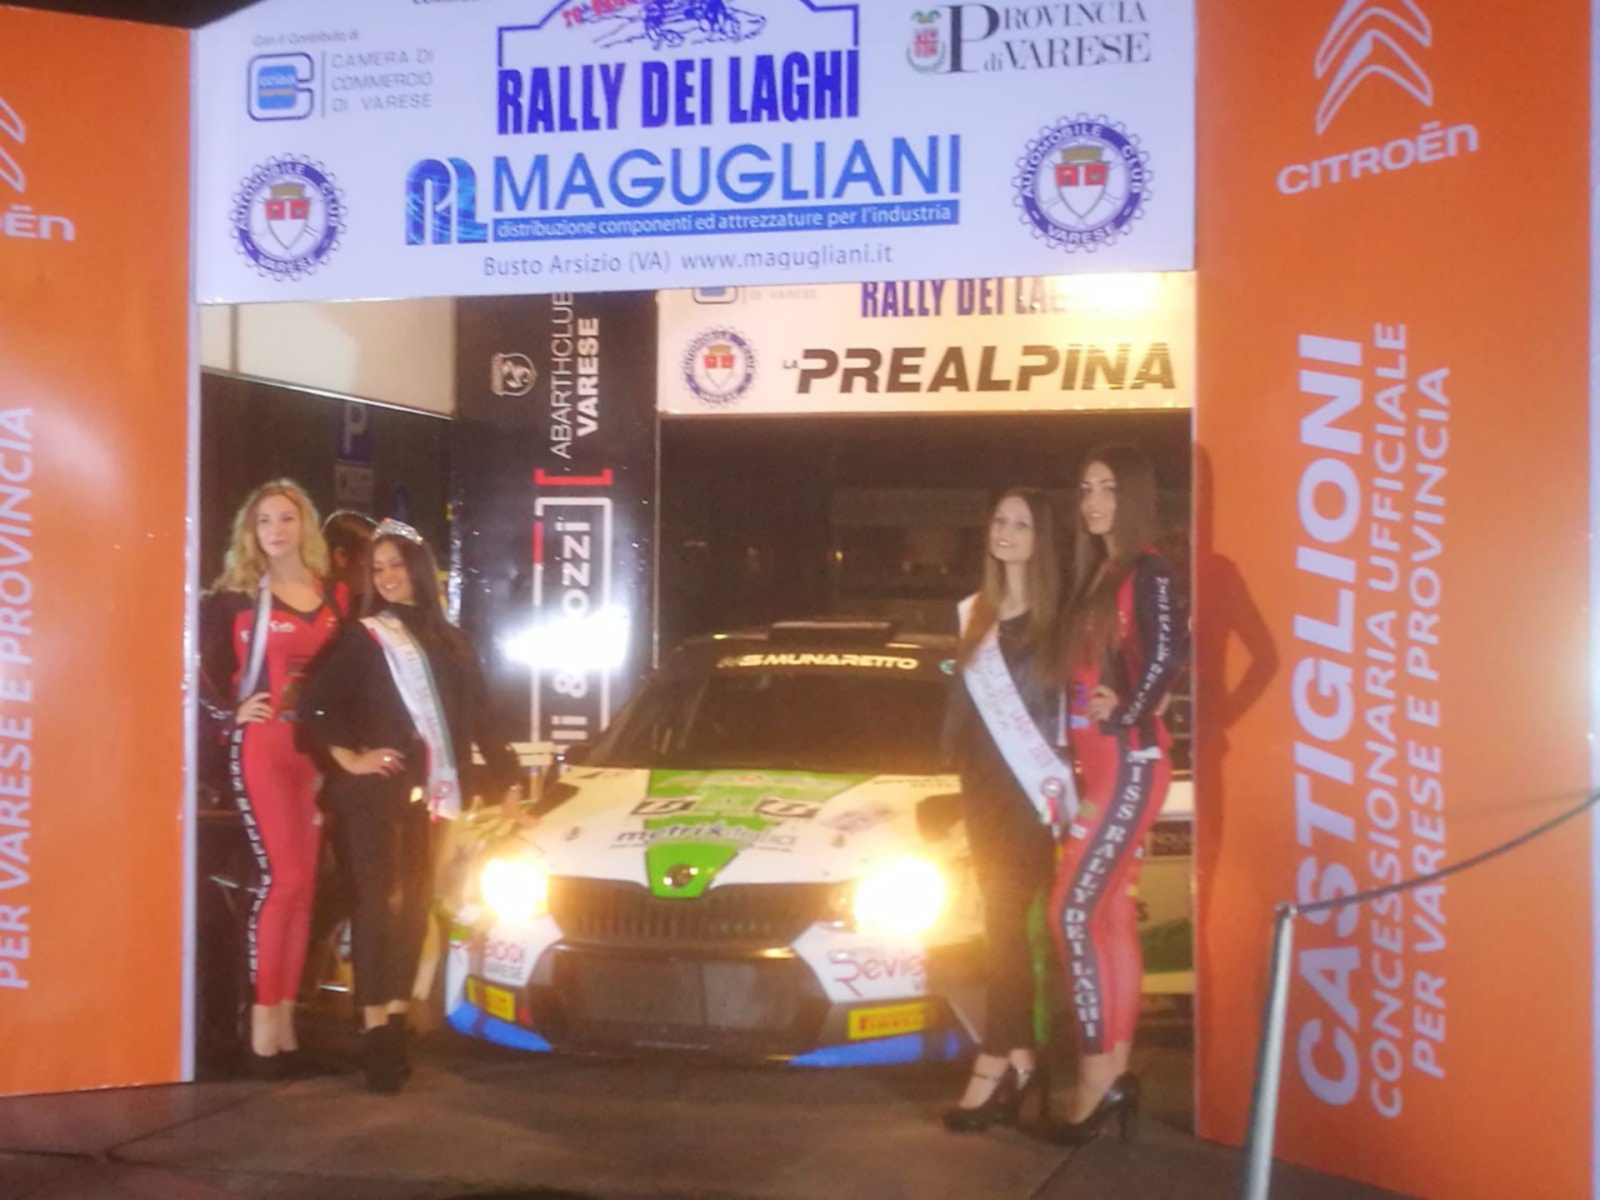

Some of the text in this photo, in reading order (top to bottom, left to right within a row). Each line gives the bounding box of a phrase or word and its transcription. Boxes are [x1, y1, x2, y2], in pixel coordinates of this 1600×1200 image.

[330, 71, 433, 92] COMMERCIO
[331, 48, 433, 69] CAMERA DI
[1004, 33, 1151, 70] VARESE
[332, 93, 433, 112] DI VARESE
[497, 49, 860, 135] RALLY DEI LAGHI
[493, 134, 961, 213] MAGUGLIANI
[1021, 122, 1143, 198] AUTOMOBILE CLUB
[498, 204, 951, 239] distribuzione componenti ed attrezzature per l'industria
[1046, 222, 1117, 244] VARESE
[484, 243, 893, 277] Busto Arsizio (VA) www.magugliani.it
[861, 279, 946, 317] RALLY
[576, 317, 599, 437] VARESE
[783, 359, 799, 370] LA
[797, 342, 1177, 394] PREALPINA
[0, 407, 33, 665] PROVINCIA
[1290, 333, 1363, 1106] CASTIGLIONI
[1363, 322, 1408, 1119] CONCESSIONARIA UFFICIALE
[1405, 366, 1451, 1079] PER VARESE E PROVINCIA
[0, 714, 32, 890] VARESE
[0, 904, 30, 989] PER
